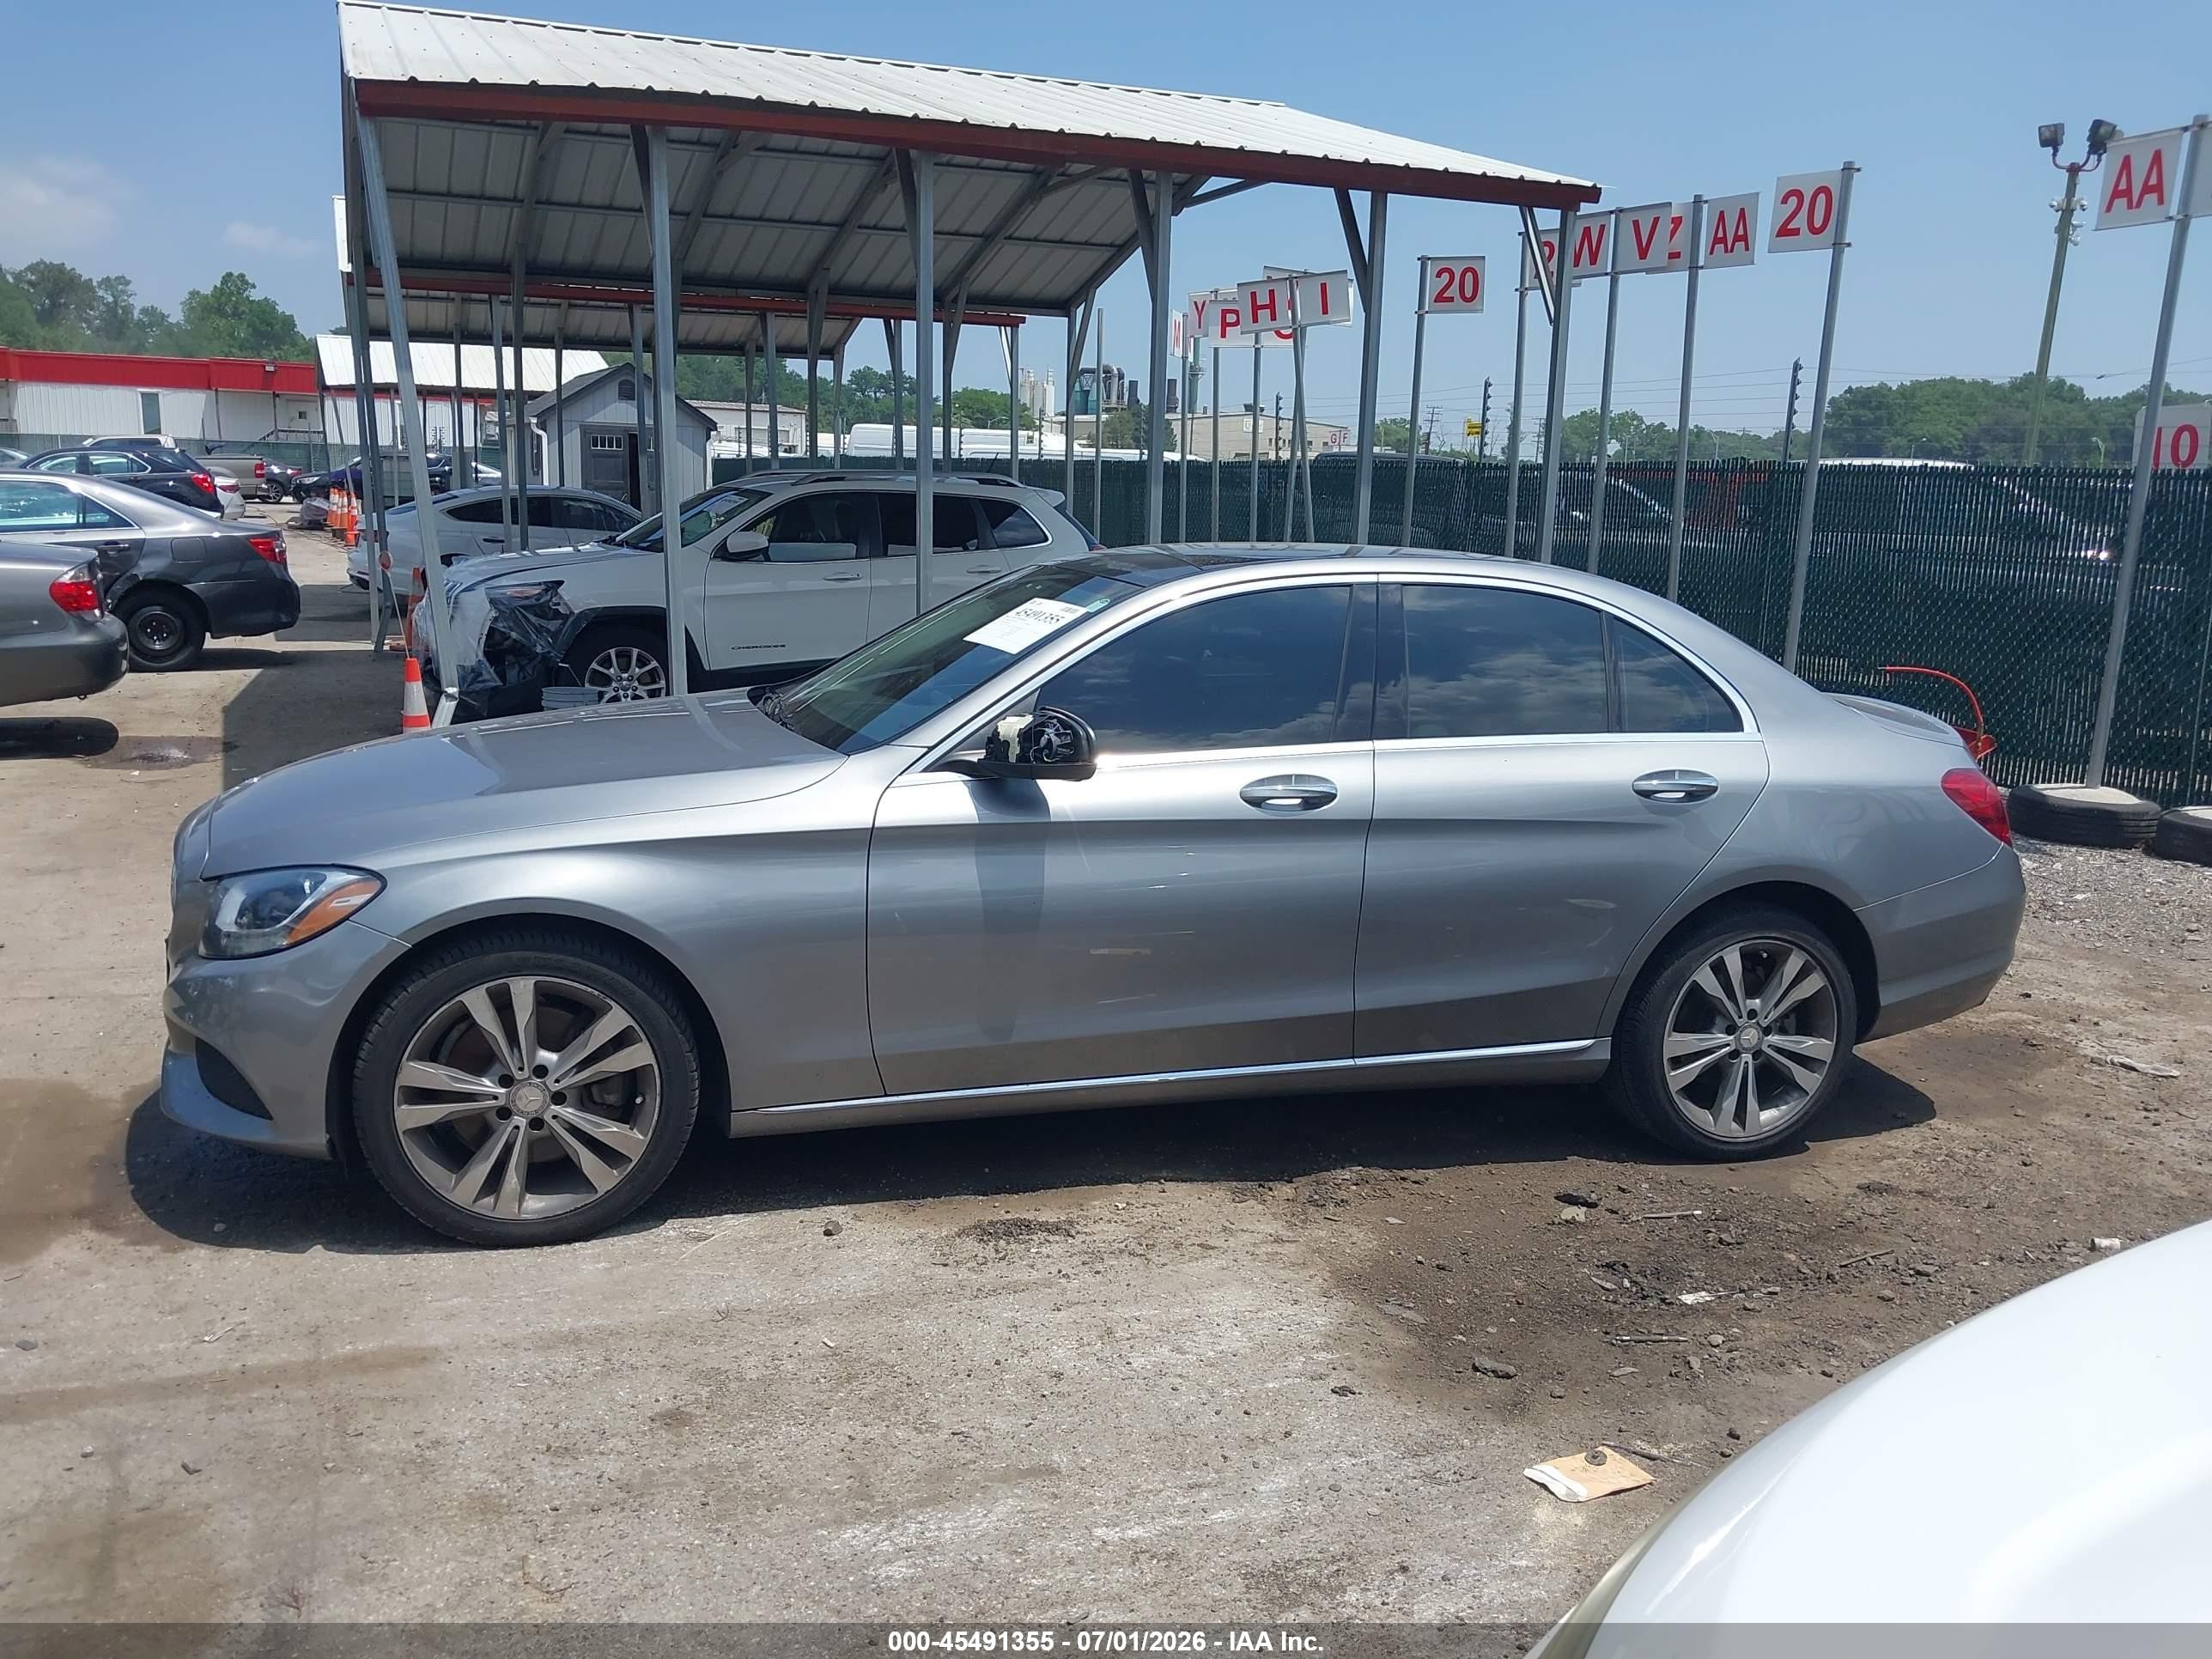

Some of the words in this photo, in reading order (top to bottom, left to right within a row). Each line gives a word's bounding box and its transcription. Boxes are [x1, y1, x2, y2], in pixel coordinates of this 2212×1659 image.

[2105, 149, 2165, 213] AA
[1776, 185, 1833, 239] 20
[1632, 216, 1660, 260] V
[1710, 207, 1750, 256] AA
[1433, 266, 1479, 304] 20
[1194, 300, 1206, 329] Y
[1220, 308, 1240, 338] P
[1250, 289, 1277, 324] H
[1330, 433, 1337, 444] G
